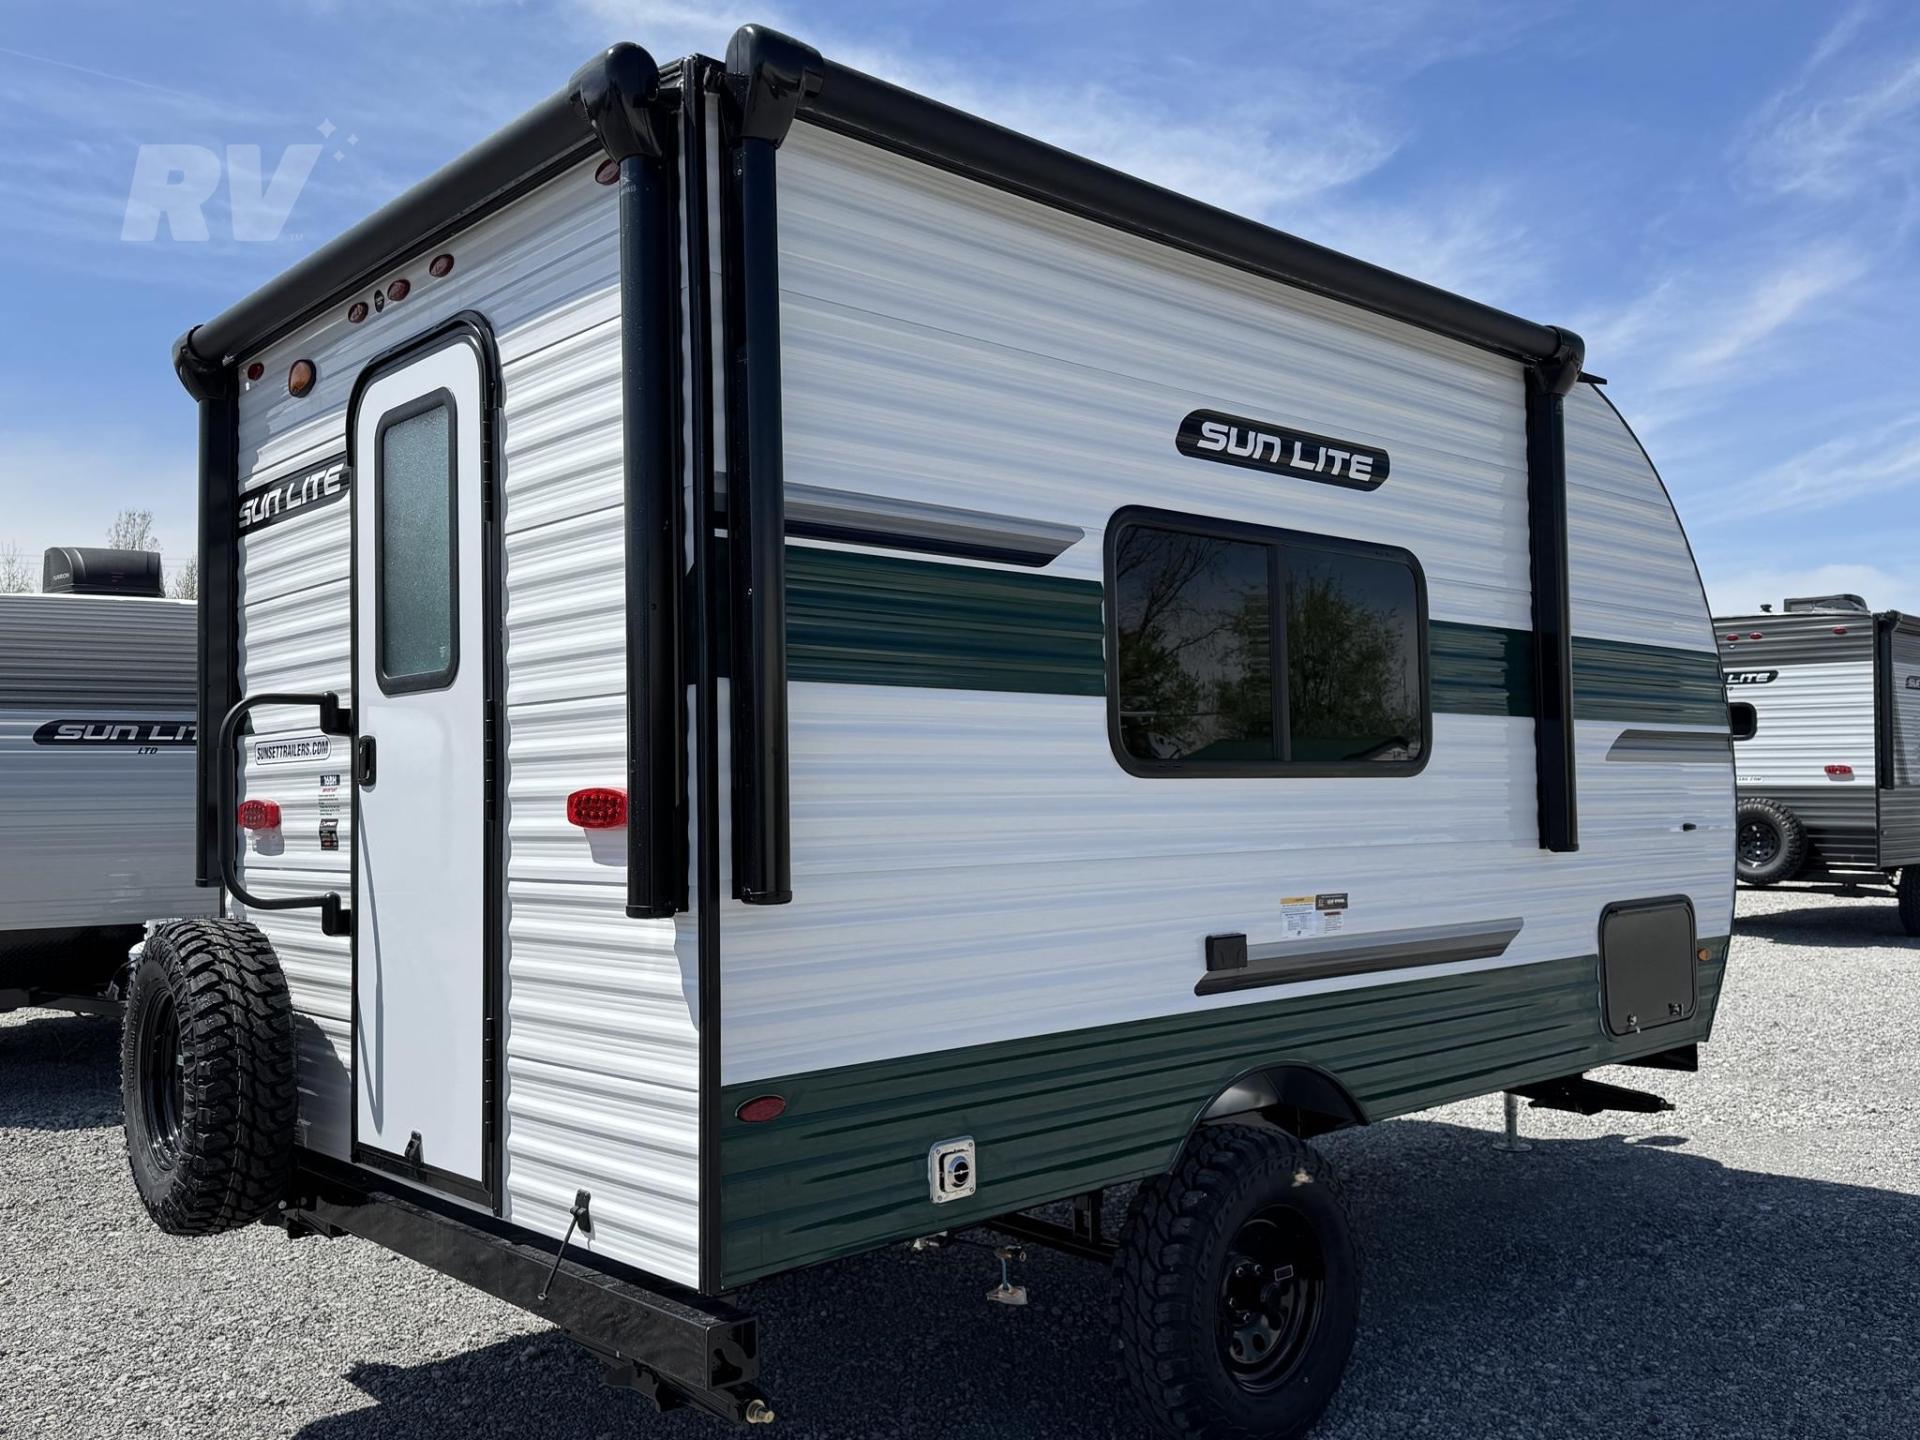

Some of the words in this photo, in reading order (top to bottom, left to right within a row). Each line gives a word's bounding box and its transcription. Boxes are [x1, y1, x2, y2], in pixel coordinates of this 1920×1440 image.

[1197, 421, 1282, 463] SUN
[1290, 440, 1374, 482] LITE
[239, 487, 283, 528] SUN
[285, 462, 345, 510] LITE
[1726, 672, 1771, 684] LITE
[53, 724, 140, 741] SUN
[136, 746, 159, 756] LTD
[256, 740, 330, 761] SUNSETTRAILERS.COM
